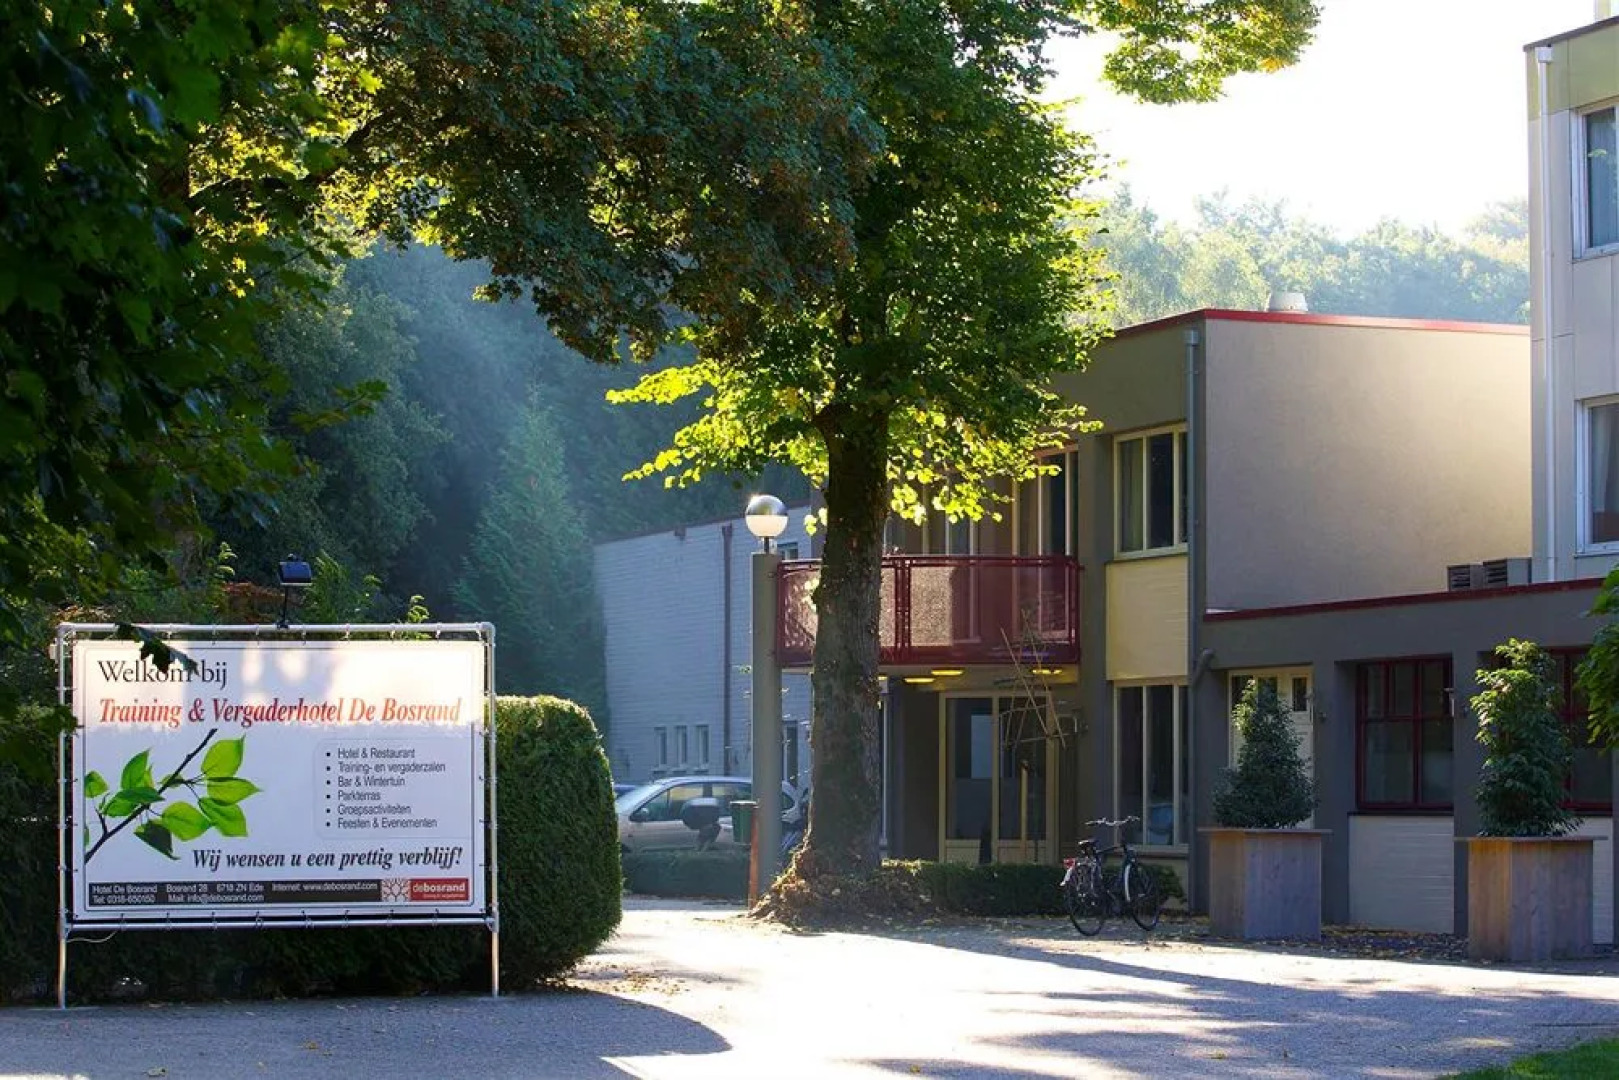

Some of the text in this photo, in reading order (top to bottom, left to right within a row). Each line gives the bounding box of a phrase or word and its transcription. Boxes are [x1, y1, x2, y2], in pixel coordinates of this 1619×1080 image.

[98, 659, 228, 690] Welkom bij
[99, 696, 462, 729] Training & Vergaderhotel De Bosrand
[337, 747, 415, 759] Hotel & Restaurant
[338, 761, 446, 774] Training- en vergaderzalen
[338, 775, 405, 787] Bar & Wintertuin
[337, 789, 381, 801] Parkterras
[337, 803, 411, 816] Groepsactiviteiten
[337, 817, 438, 829] Feesten & Evenementen
[193, 846, 464, 871] Wij wensen u een prettig verblijf!
[126, 883, 158, 893] Bosrand
[166, 883, 197, 893] Bosrand
[412, 882, 466, 893] debosrand
